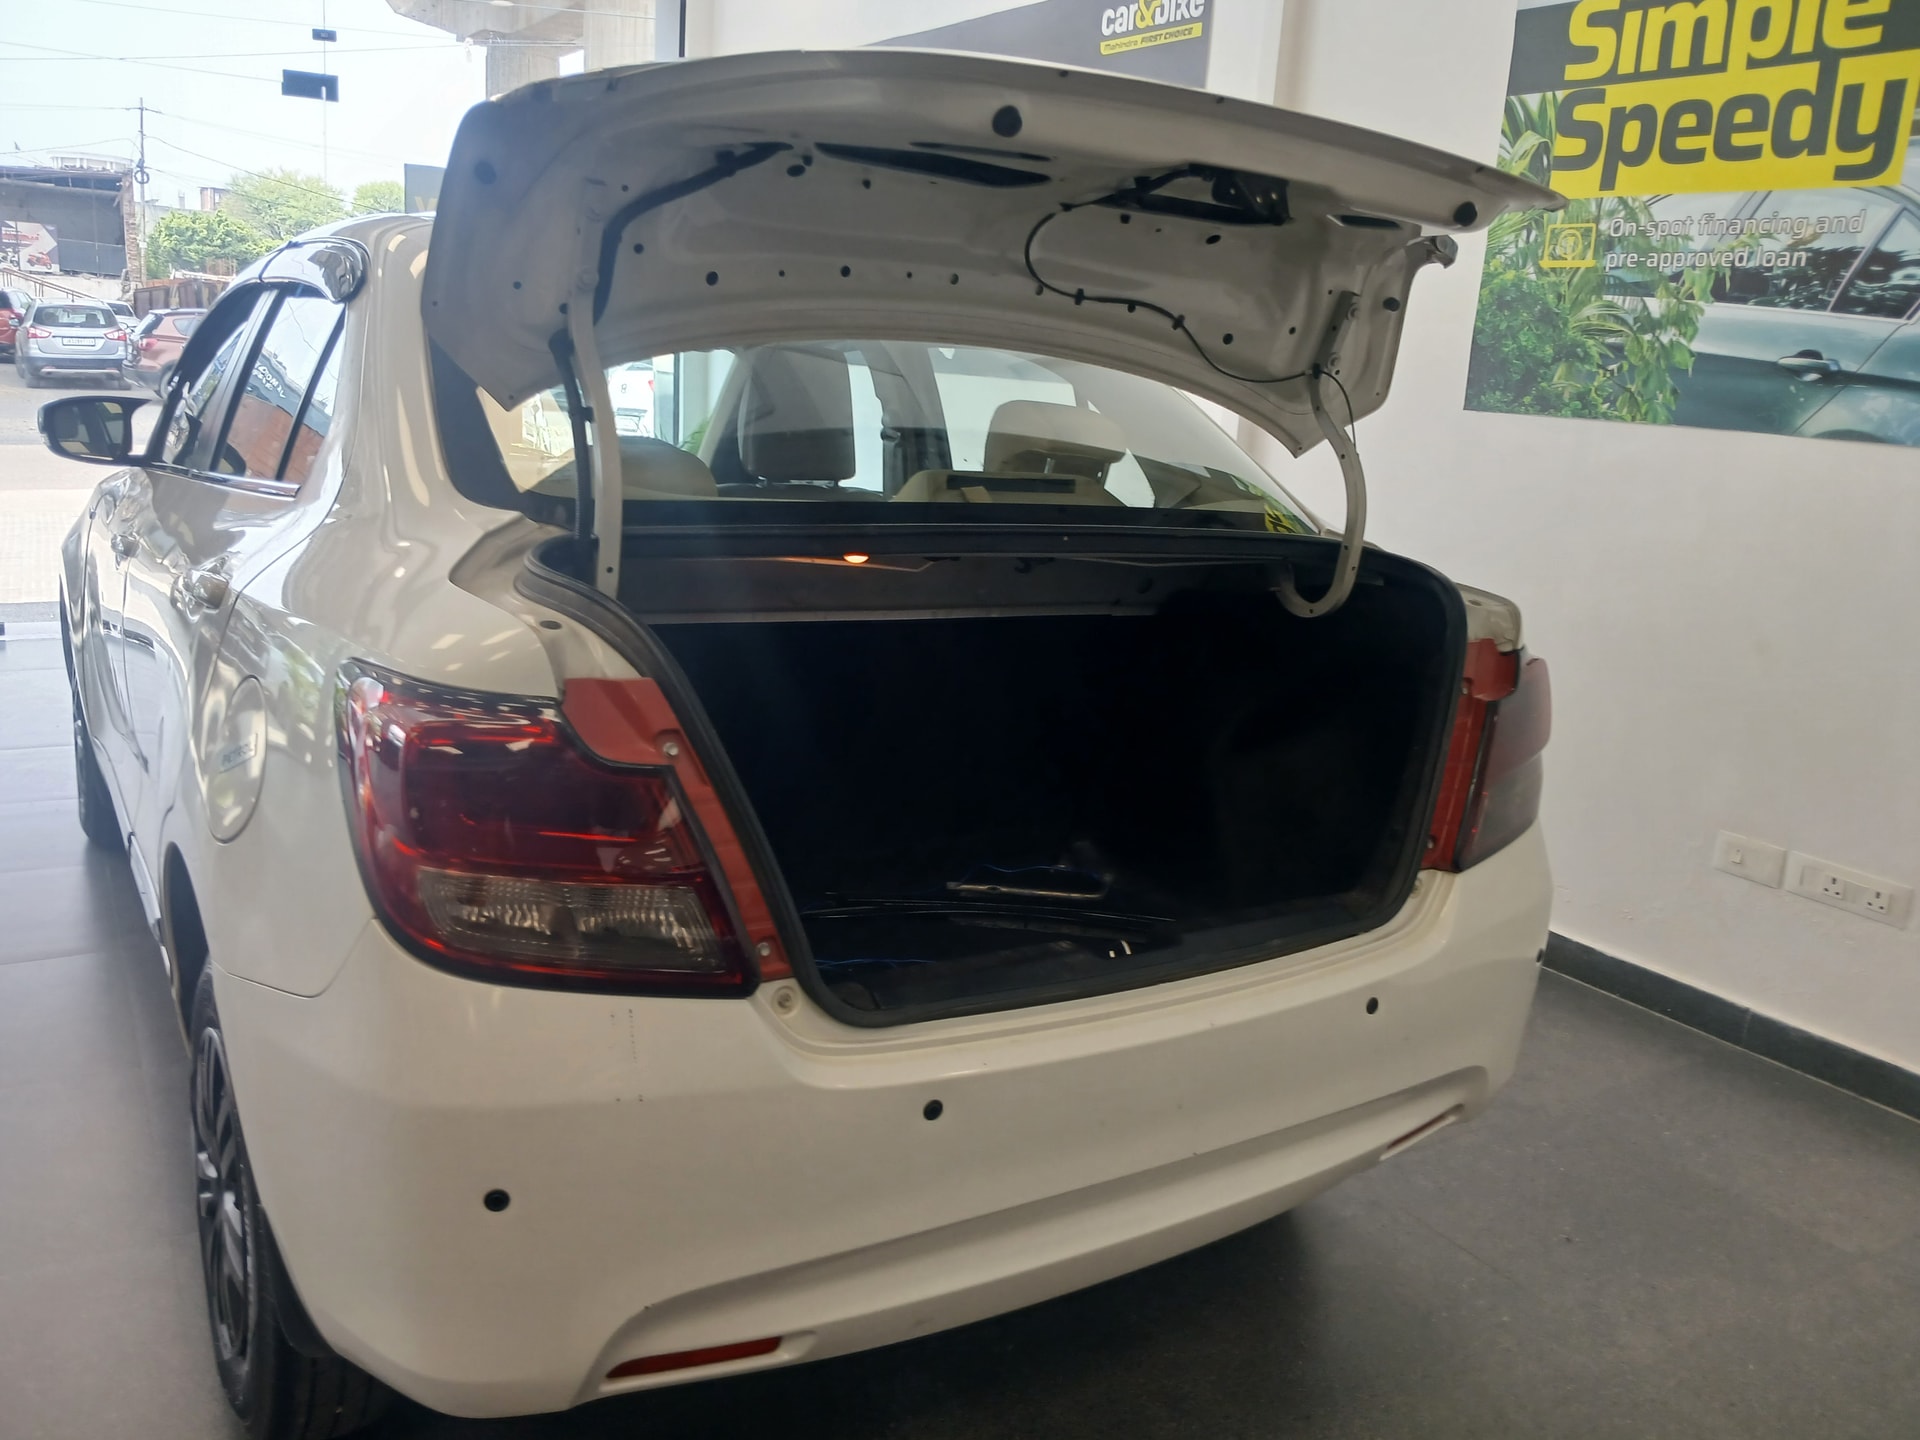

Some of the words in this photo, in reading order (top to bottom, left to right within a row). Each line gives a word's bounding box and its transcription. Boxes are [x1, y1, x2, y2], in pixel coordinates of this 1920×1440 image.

[1140, 33, 1163, 45] FIRST
[1164, 27, 1193, 41] CHOICE
[1564, 0, 1890, 81] Simple
[1553, 60, 1909, 192] Speedy
[1610, 215, 1693, 241] On-spot
[1698, 211, 1809, 238] financing
[1815, 209, 1866, 234] and
[1605, 248, 1748, 273] pre-approved
[1755, 246, 1807, 268] loan
